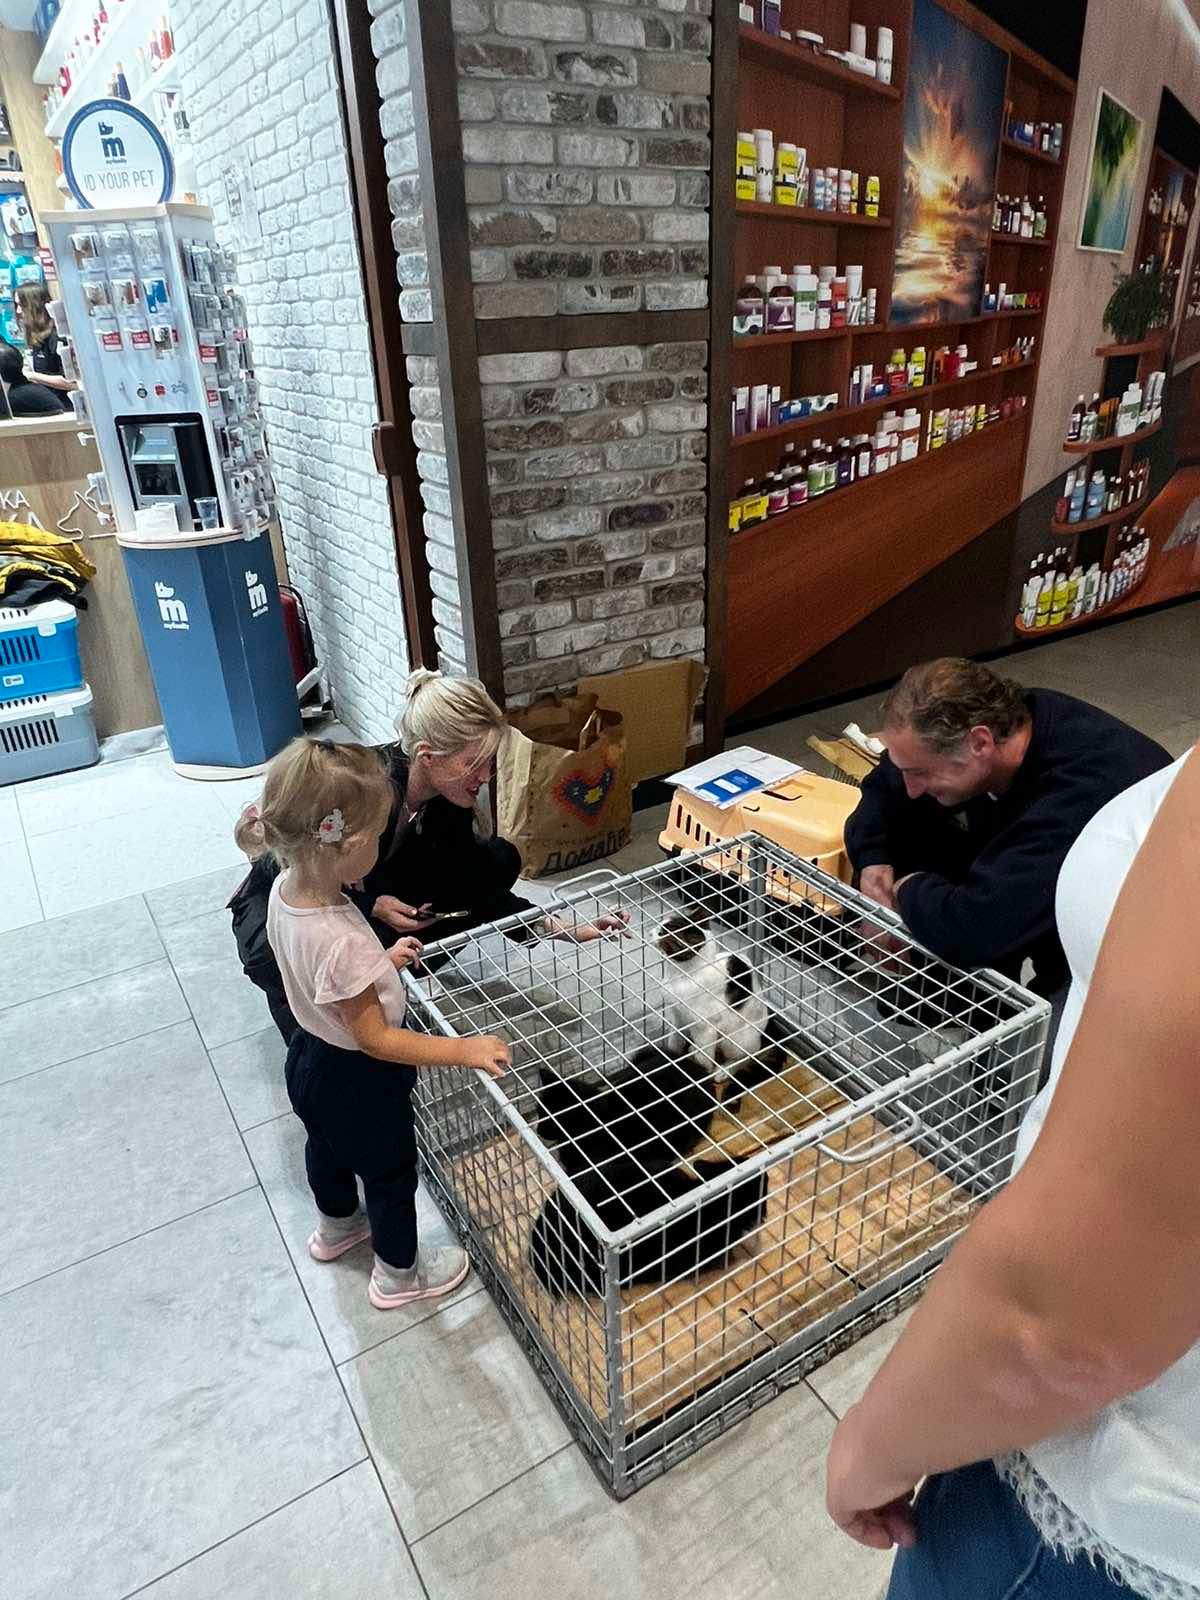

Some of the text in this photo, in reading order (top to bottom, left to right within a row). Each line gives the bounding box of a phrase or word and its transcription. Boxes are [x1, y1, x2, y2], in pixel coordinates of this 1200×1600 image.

[84, 169, 155, 191] ID YOUR PET
